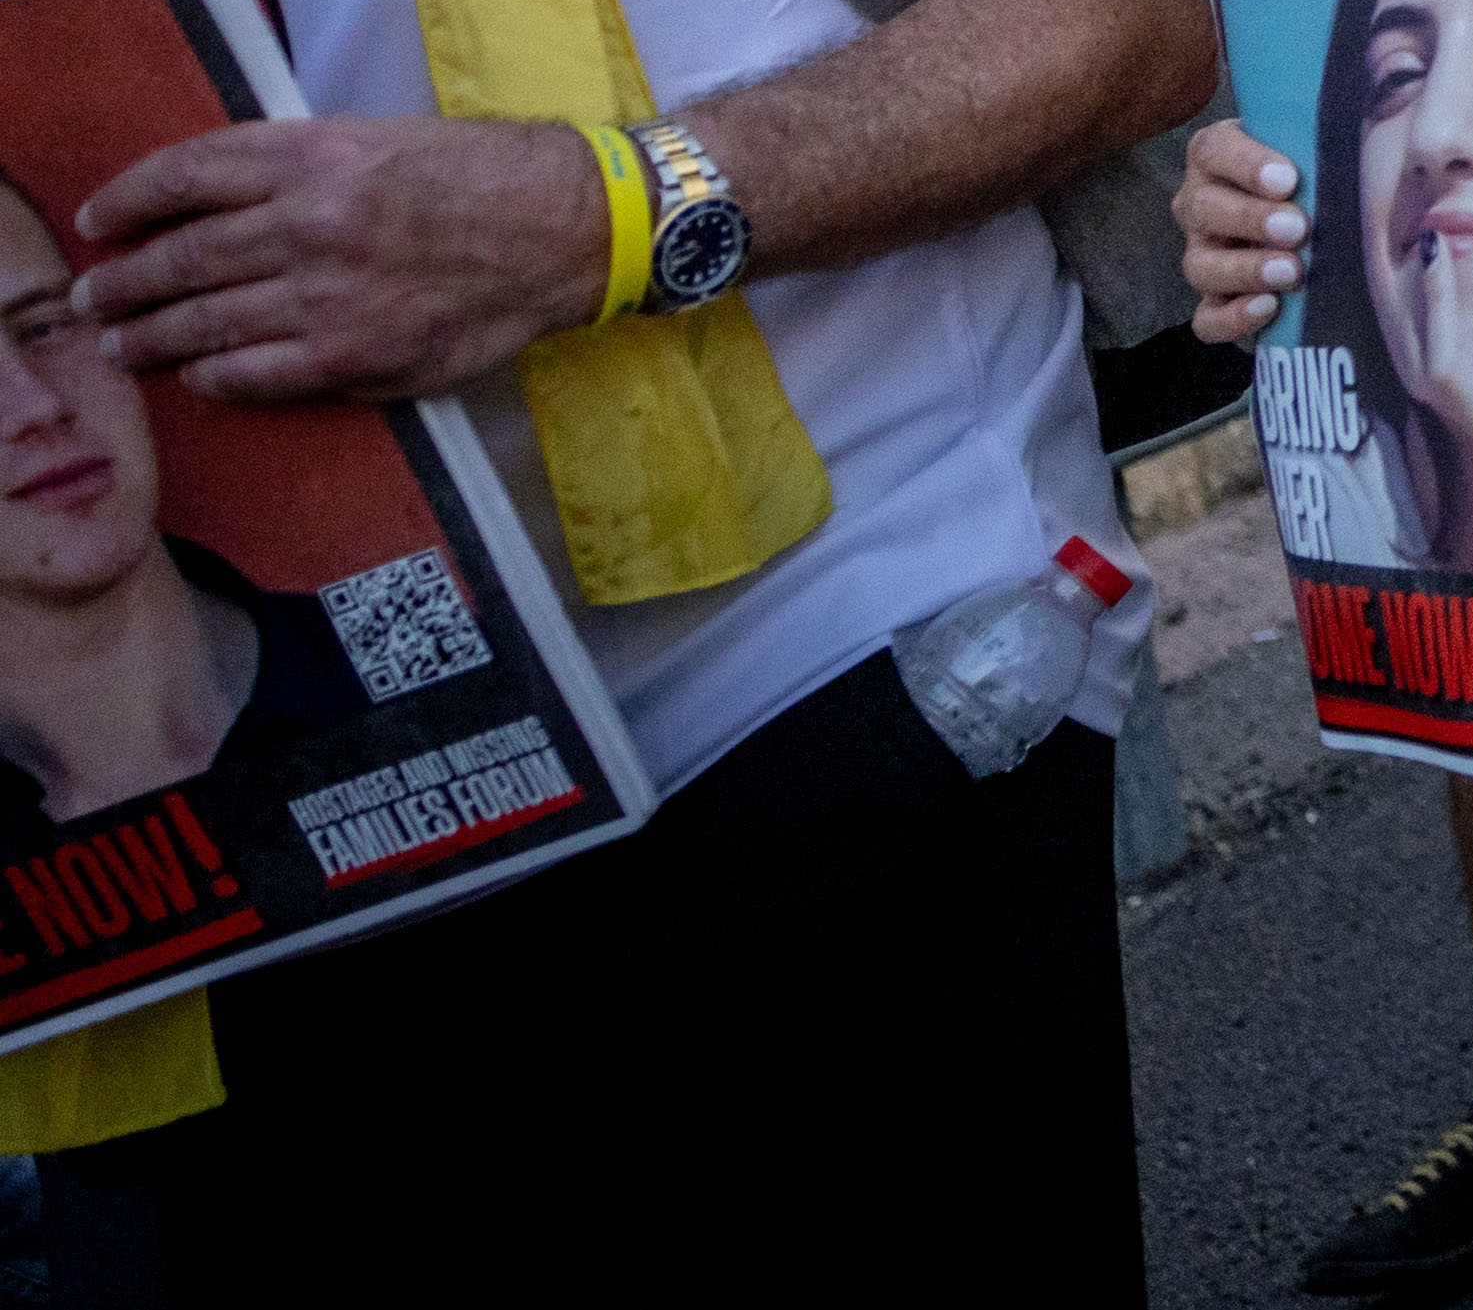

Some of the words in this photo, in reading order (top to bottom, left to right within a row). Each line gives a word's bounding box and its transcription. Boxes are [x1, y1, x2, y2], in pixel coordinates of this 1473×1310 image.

[1255, 345, 1361, 453] BRING
[287, 765, 404, 830] HOSTAGES
[443, 714, 552, 774] MISSING
[305, 785, 459, 879] FAMILIES
[453, 746, 578, 832] FORUM
[5, 790, 239, 956] NOW!
